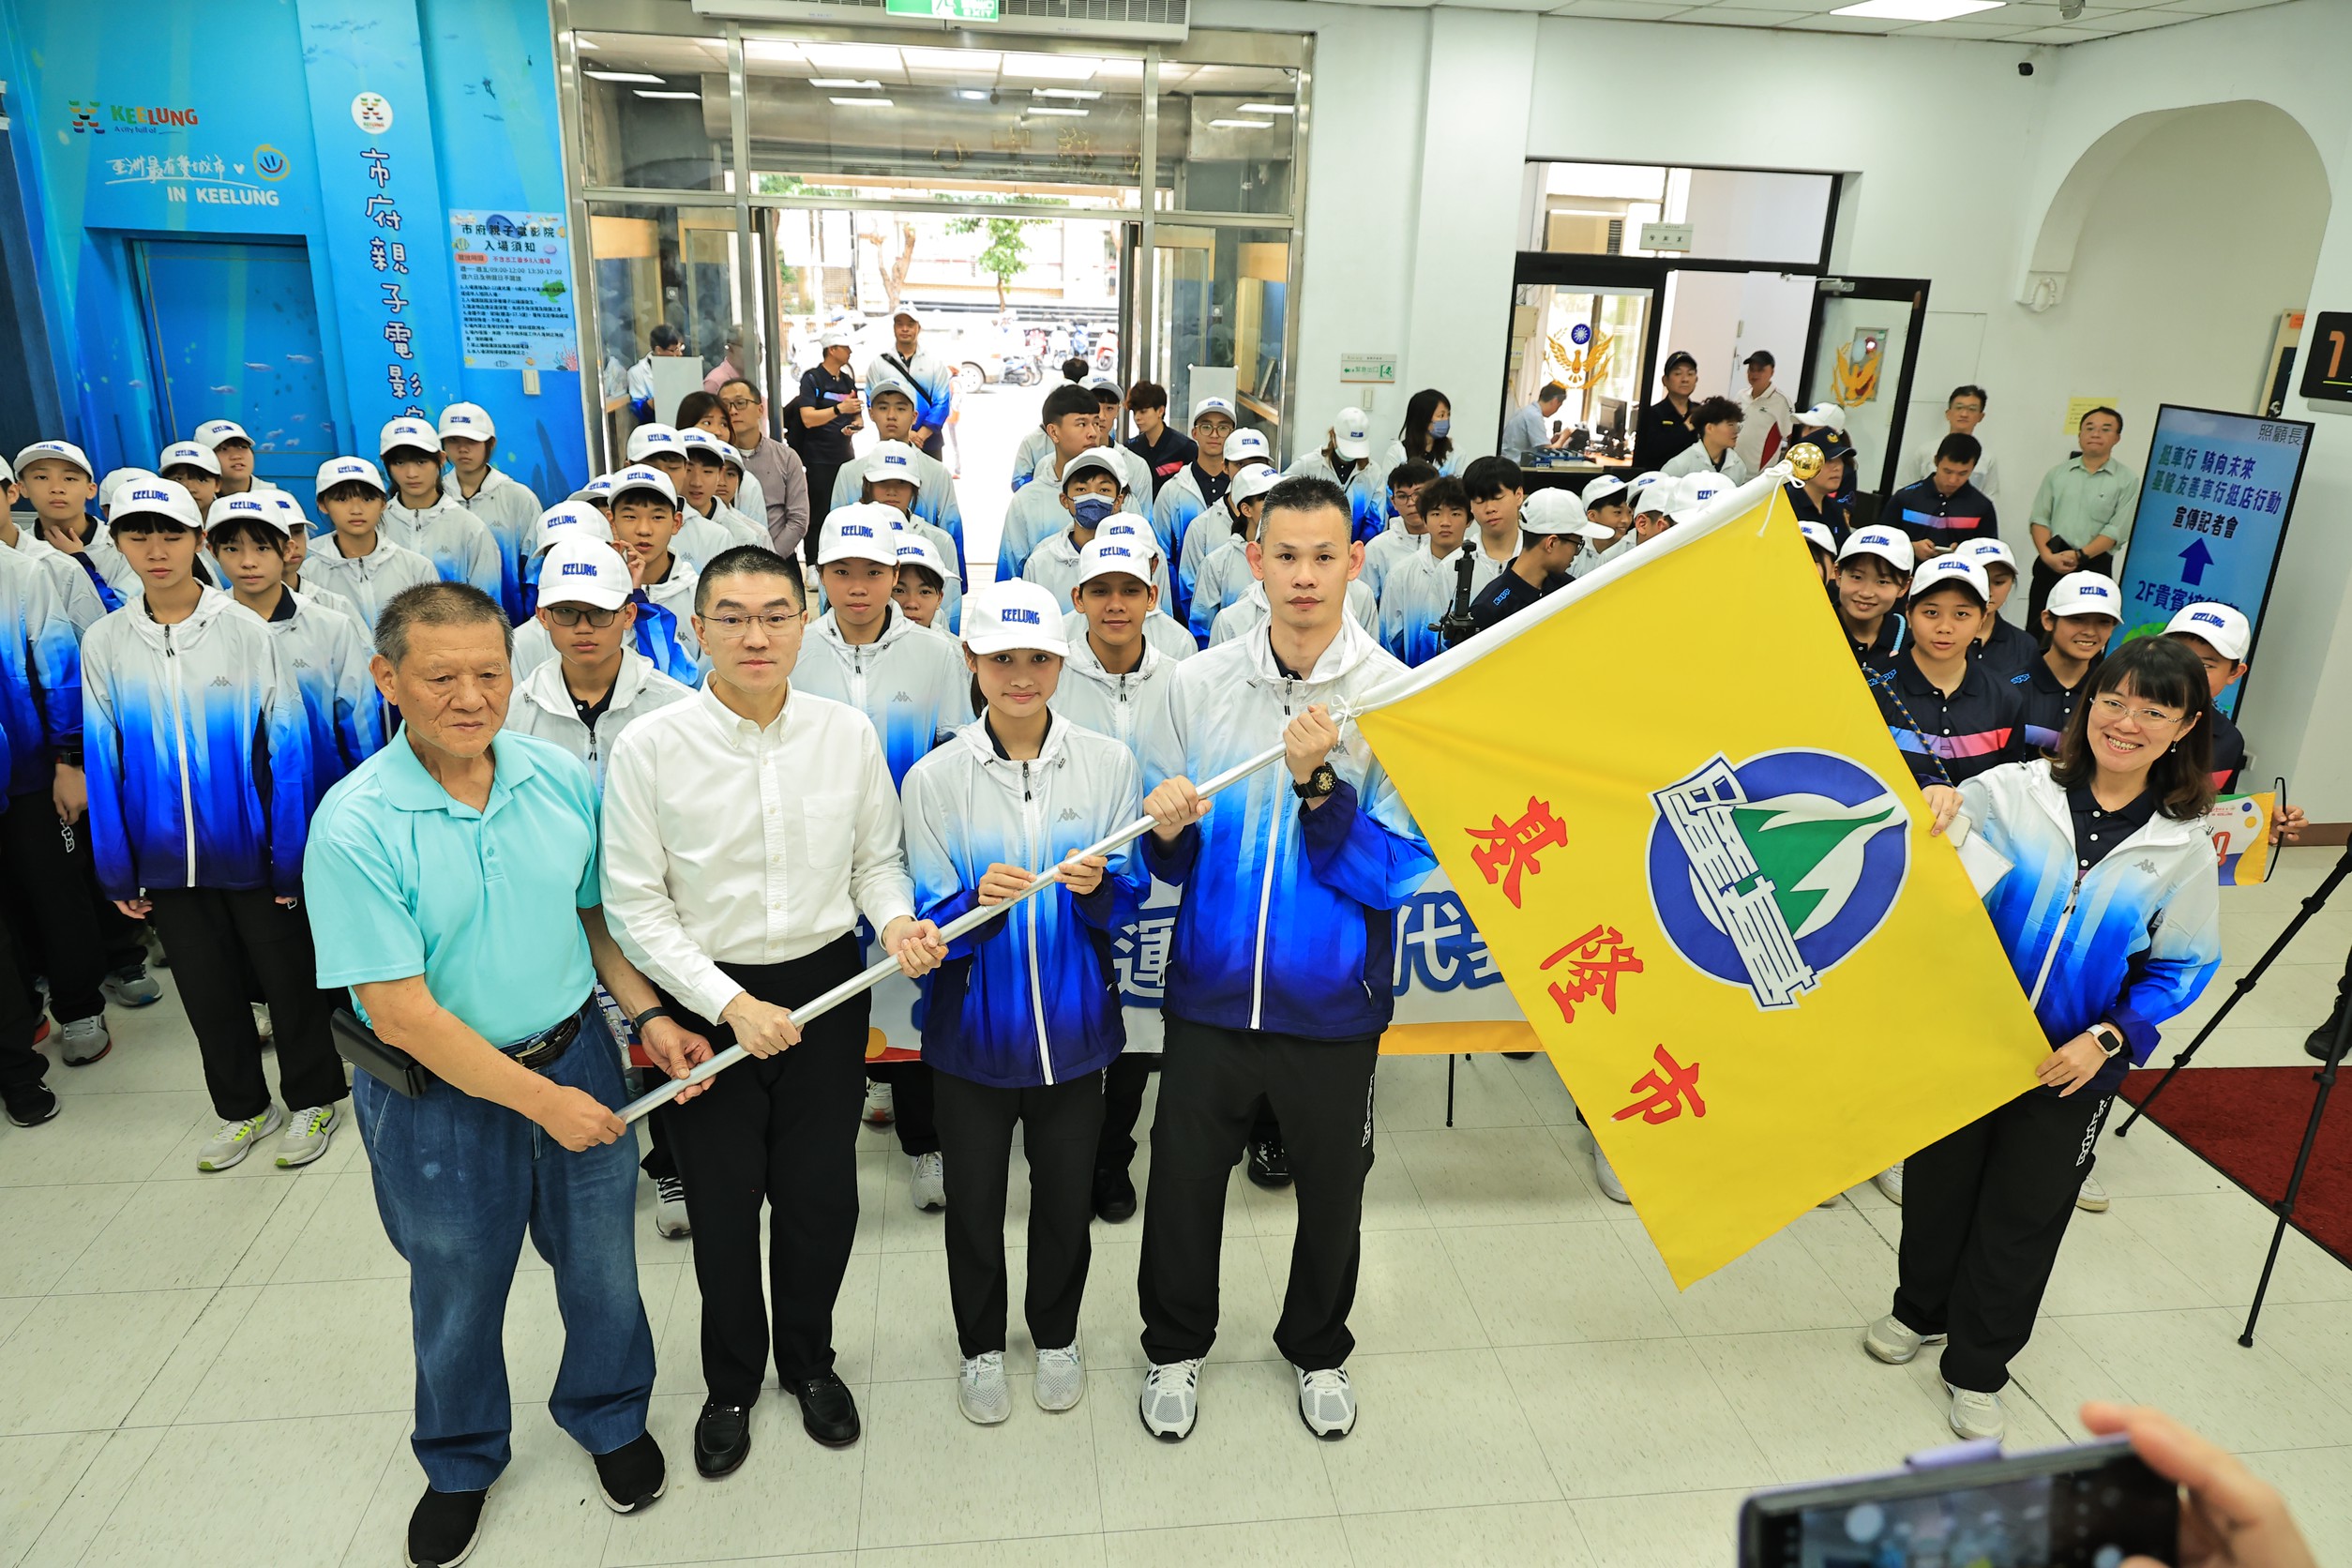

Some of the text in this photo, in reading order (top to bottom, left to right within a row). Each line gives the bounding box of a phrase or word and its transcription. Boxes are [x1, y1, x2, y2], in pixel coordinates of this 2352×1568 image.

[110, 104, 199, 127] KEELUNG
[167, 186, 279, 206] IN KEELUNG
[461, 222, 555, 238] 市府親子電影院
[484, 239, 535, 253] 入場須知
[648, 434, 671, 443] KEELUNG
[884, 456, 907, 466] KEELUNG
[2200, 449, 2257, 481] 騎向未來
[626, 472, 656, 482] KEELUNG
[132, 490, 170, 503] KEELUNG
[2151, 469, 2283, 516] 基隆友善車行挺店行動
[230, 501, 263, 512] KEELUNG
[547, 515, 578, 529] KEELUNG
[2172, 505, 2239, 540] 宣傳記者會
[841, 524, 874, 539] KEELUNG
[1109, 525, 1136, 535] KEELUNG
[1860, 535, 1891, 547] KEELUNG
[897, 546, 925, 557] KEELUNG
[1099, 547, 1131, 558] KEELUNG
[562, 562, 598, 578] KEELUNG
[1937, 561, 1971, 573] KEELUNG
[1001, 608, 1041, 626] KEELUNG
[2190, 611, 2225, 629] KEELUNG
[1464, 795, 1707, 1125] 基隆市
